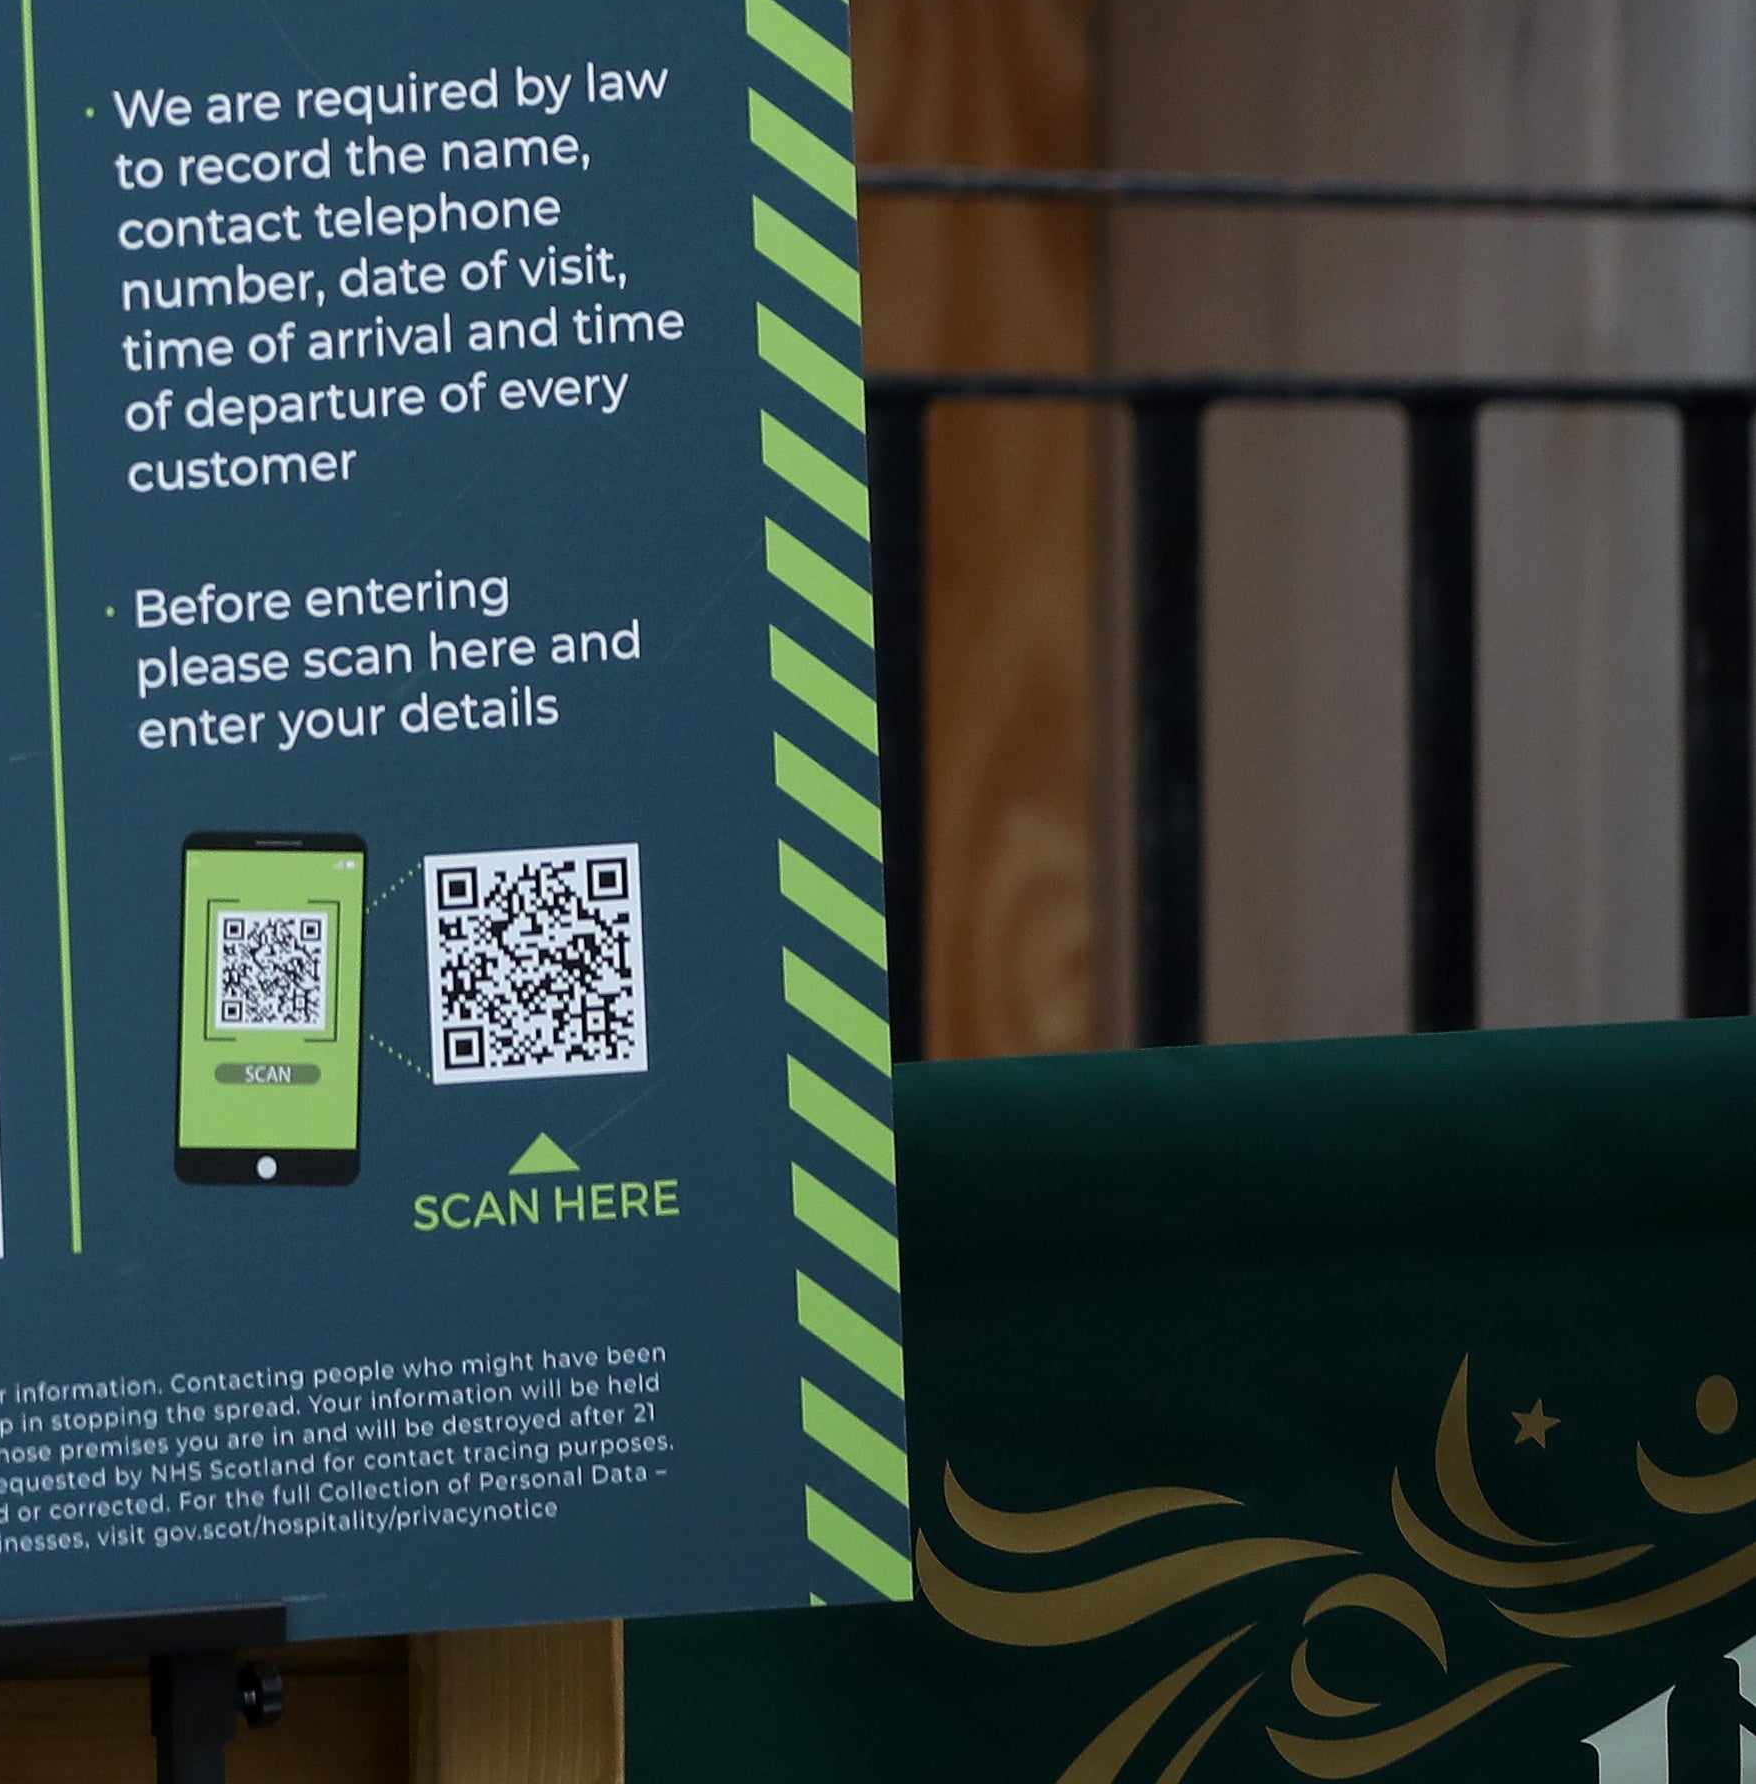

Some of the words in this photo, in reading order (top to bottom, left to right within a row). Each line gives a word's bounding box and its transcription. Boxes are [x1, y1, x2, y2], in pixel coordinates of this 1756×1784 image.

[112, 88, 193, 129] We
[206, 90, 282, 125] are
[297, 67, 498, 126] required
[515, 65, 572, 115] by
[586, 61, 669, 103] law
[114, 153, 164, 190] to
[179, 137, 331, 187] record
[345, 134, 427, 177] the
[442, 134, 590, 172] name,
[118, 204, 303, 251] contact
[314, 191, 561, 244] telephone
[122, 263, 325, 312] number,
[339, 256, 447, 299] date
[460, 248, 509, 291] of
[518, 242, 627, 290] visit,
[122, 328, 234, 372] time
[247, 320, 297, 364] of
[308, 312, 452, 361] arrival
[468, 305, 558, 352] and
[572, 302, 685, 346] time
[125, 388, 174, 432] of
[184, 384, 426, 435] departure
[439, 370, 488, 414] of
[499, 372, 629, 415] every
[127, 449, 357, 493] customer
[135, 582, 292, 629] Before
[305, 568, 509, 618] entering
[138, 645, 290, 699] please
[303, 642, 413, 679] scan
[429, 630, 536, 672] here
[551, 618, 641, 664] and
[138, 709, 266, 750] enter
[278, 704, 386, 752] your
[400, 685, 559, 734] details
[244, 1064, 292, 1084] SCAN
[413, 1187, 539, 1232] SCAN
[554, 1178, 680, 1223] HERE
[16, 1375, 163, 1404] information.
[170, 1367, 304, 1394] Contacting
[313, 1359, 395, 1389] people
[402, 1356, 454, 1379] who
[462, 1351, 534, 1378] might
[542, 1348, 598, 1370] have
[607, 1345, 666, 1366] been
[22, 1413, 43, 1433] in
[51, 1406, 158, 1433] stopping
[166, 1402, 206, 1424] the
[214, 1395, 301, 1424] spread.
[308, 1394, 363, 1414] Your
[371, 1383, 512, 1411] information
[520, 1378, 561, 1400] will
[570, 1377, 599, 1397] be
[608, 1372, 660, 1395] held
[97, 1524, 146, 1547] visit
